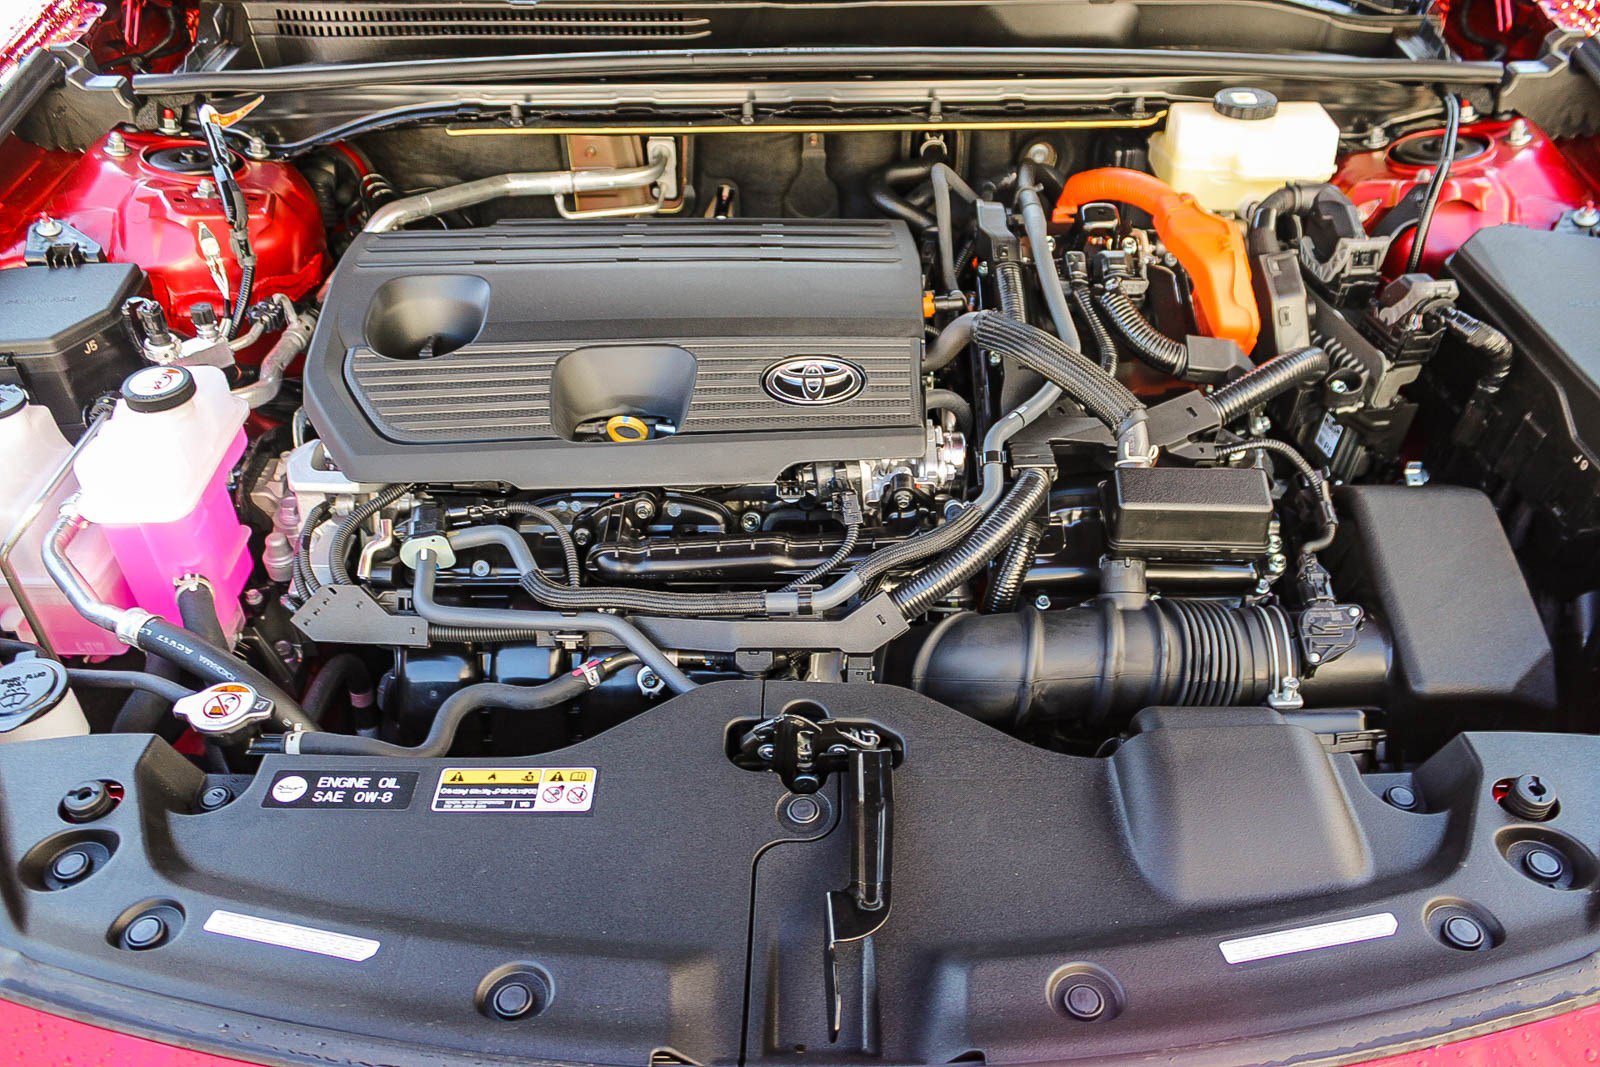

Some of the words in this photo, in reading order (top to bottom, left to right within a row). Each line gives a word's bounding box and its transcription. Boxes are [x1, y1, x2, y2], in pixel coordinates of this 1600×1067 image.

[317, 776, 372, 789] ENGINE
[378, 777, 401, 789] OIL
[312, 791, 346, 803] SAE
